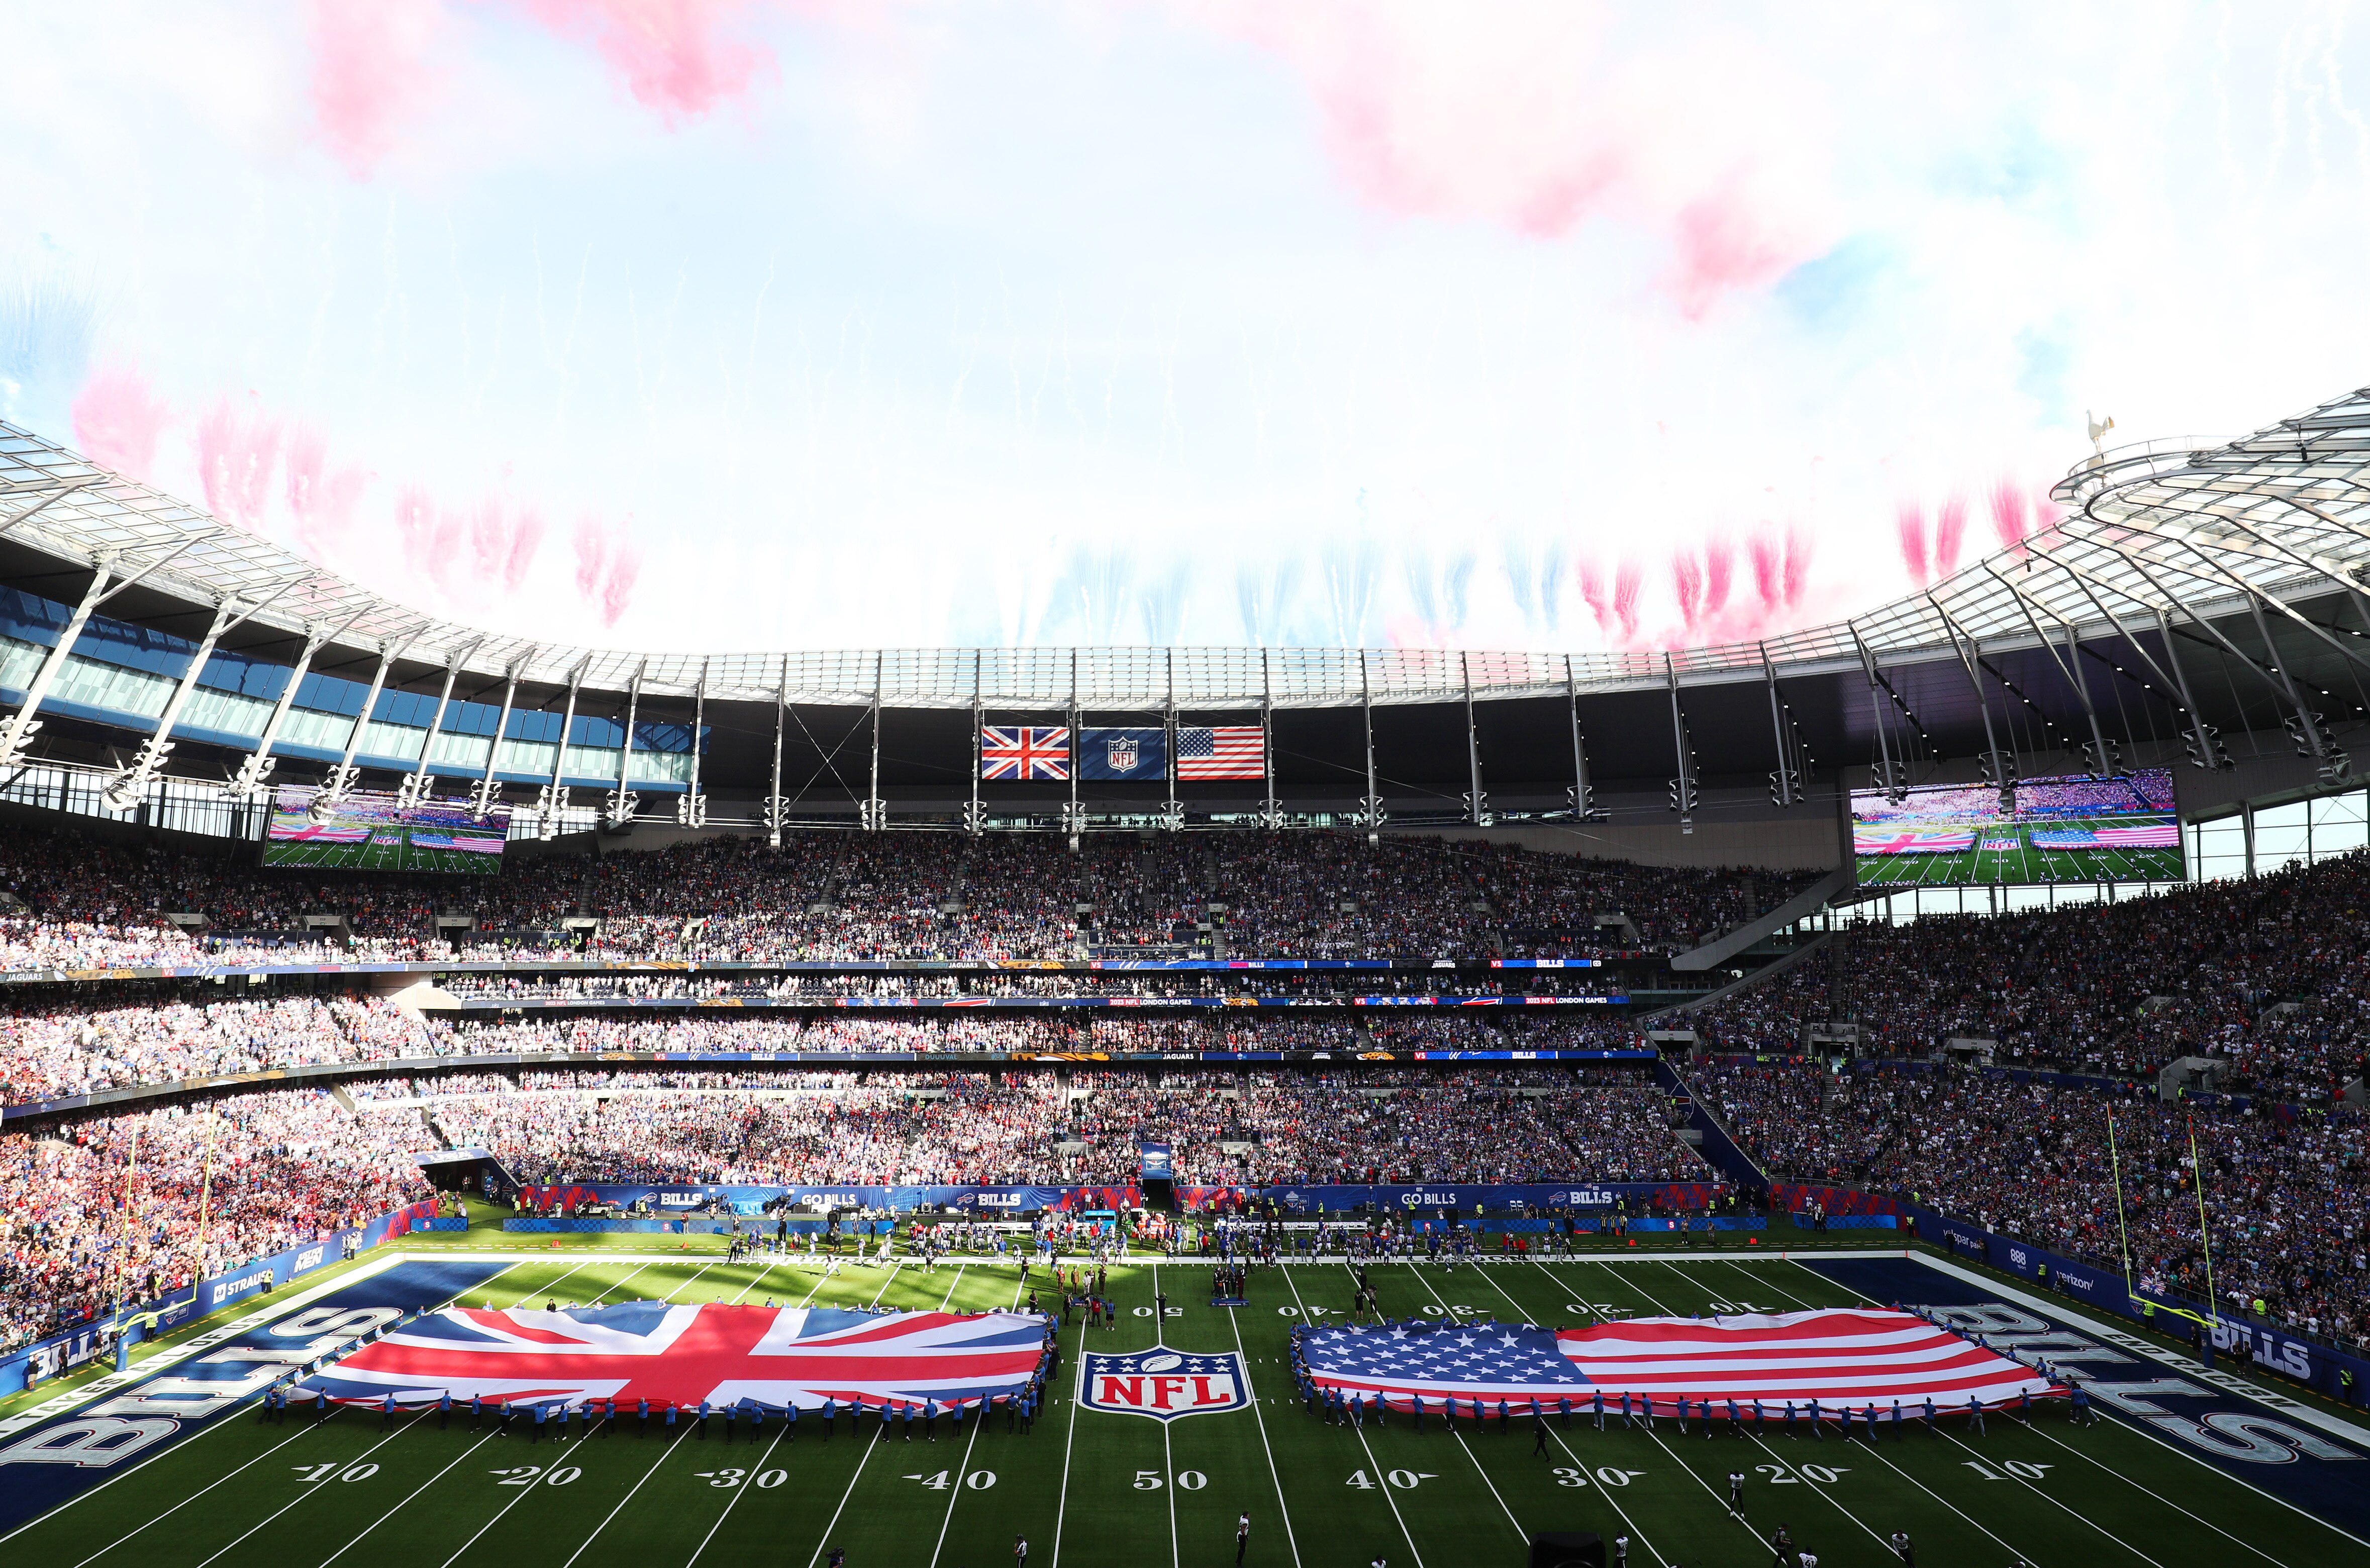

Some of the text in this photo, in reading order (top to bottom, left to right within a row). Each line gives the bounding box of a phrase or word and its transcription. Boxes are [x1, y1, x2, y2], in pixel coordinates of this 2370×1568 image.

[1112, 752, 1134, 767] NFL
[1536, 959, 1564, 967] BILLS
[6, 972, 43, 982] JAGUARS
[344, 1062, 380, 1071] JAGUARS
[661, 1193, 703, 1205] BILLS
[802, 1194, 856, 1206] GO BILLS
[978, 1194, 1021, 1206] BILLS
[1402, 1193, 1456, 1205] GO BILLS
[1570, 1192, 1612, 1204] BILLS
[293, 1253, 323, 1273] MEN
[298, 1249, 312, 1260] JUST
[2011, 1248, 2026, 1265] 888
[227, 1269, 273, 1296] STRAUS
[2056, 1270, 2091, 1291] verizon
[1133, 1307, 1183, 1317] 50
[1278, 1306, 1328, 1317] 40
[1422, 1305, 1474, 1315] 30
[1565, 1303, 1620, 1315] 20
[1710, 1302, 1763, 1313] 10
[29, 1321, 117, 1380] BILLS
[2205, 1312, 2311, 1380] BILLS
[12, 1378, 127, 1421] TAKES
[129, 1351, 189, 1372] ALL
[192, 1333, 224, 1346] OF
[231, 1317, 266, 1330] US
[2103, 1333, 2302, 1408] END RACISM
[0, 1307, 404, 1468] BILLS
[1098, 1376, 1231, 1410] NFL
[1903, 1303, 2368, 1464] BILLS
[295, 1463, 379, 1482] 10
[497, 1465, 581, 1486] 20
[710, 1468, 788, 1488] 30
[921, 1470, 996, 1490] 40
[1133, 1470, 1207, 1490] 50
[1346, 1469, 1419, 1489] 40
[1552, 1466, 1630, 1487] 30
[1755, 1463, 1838, 1484] 20
[1961, 1460, 2044, 1480] 10
